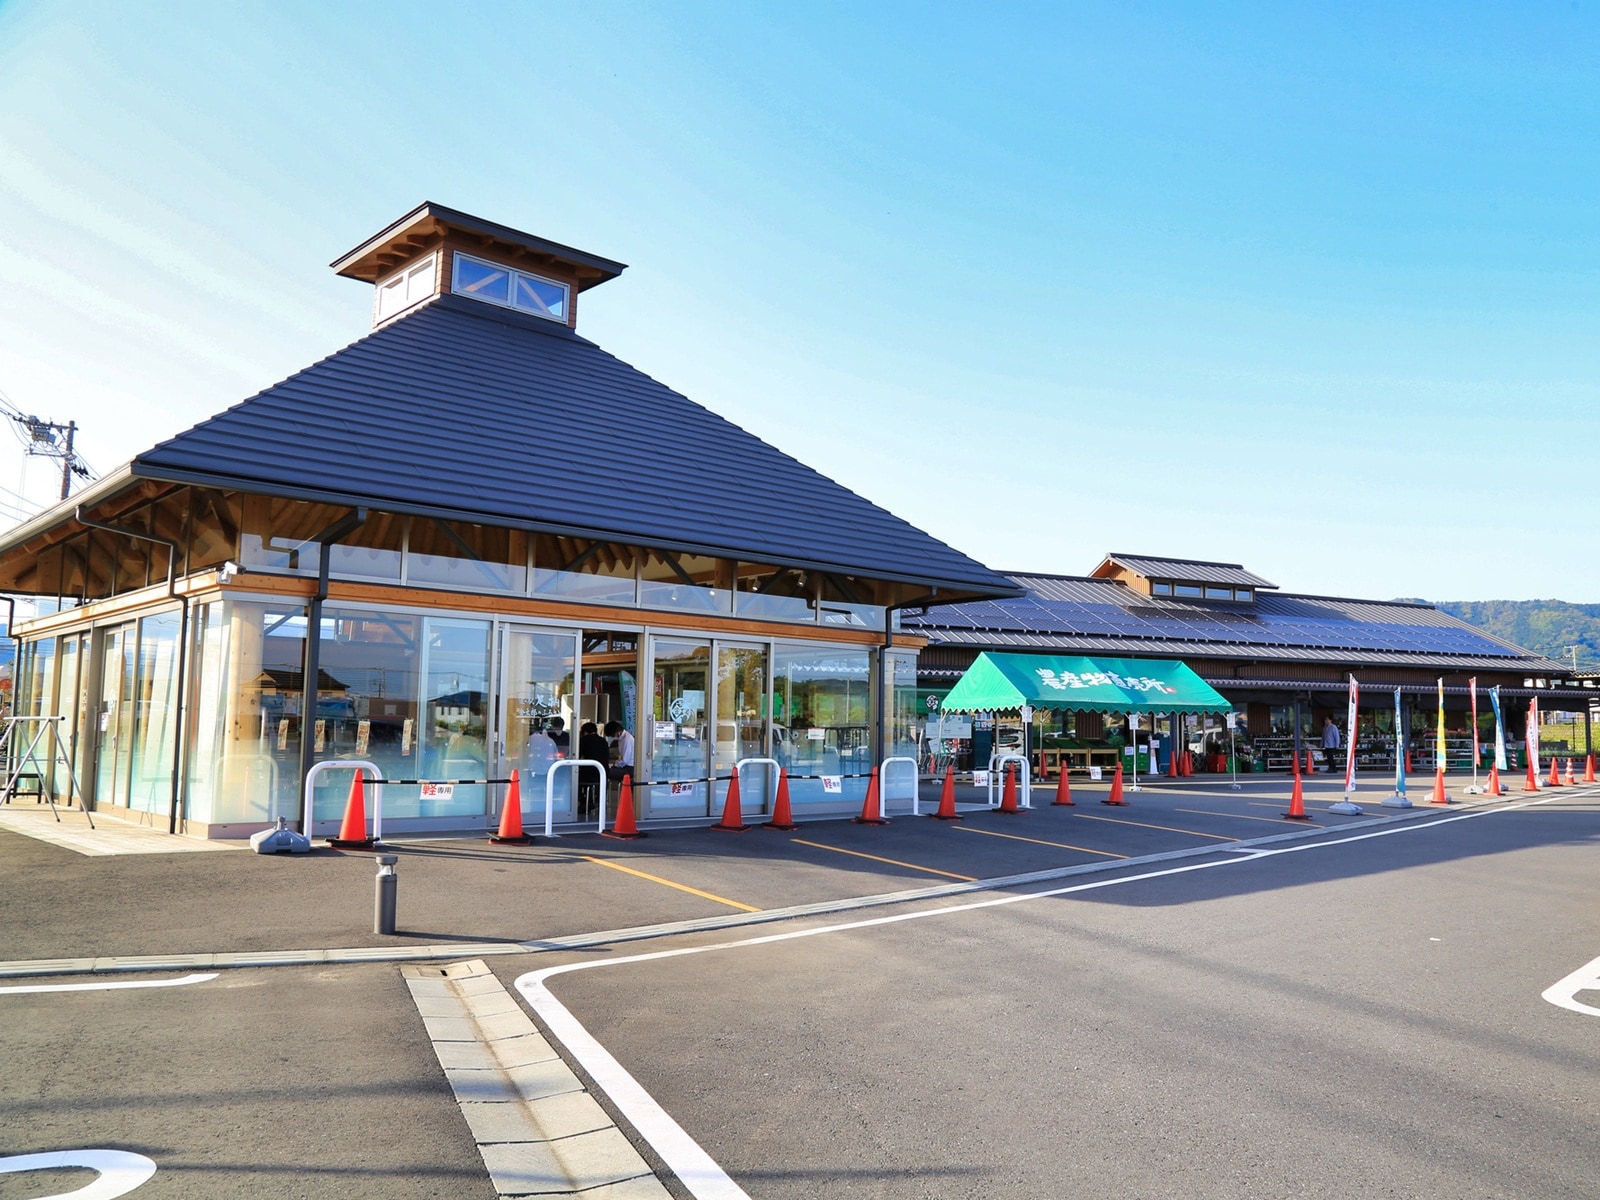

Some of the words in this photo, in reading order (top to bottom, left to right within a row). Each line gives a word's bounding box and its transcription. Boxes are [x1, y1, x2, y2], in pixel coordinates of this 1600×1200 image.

[1035, 668, 1168, 694] 農産物直売所
[422, 783, 452, 796] 軽専用
